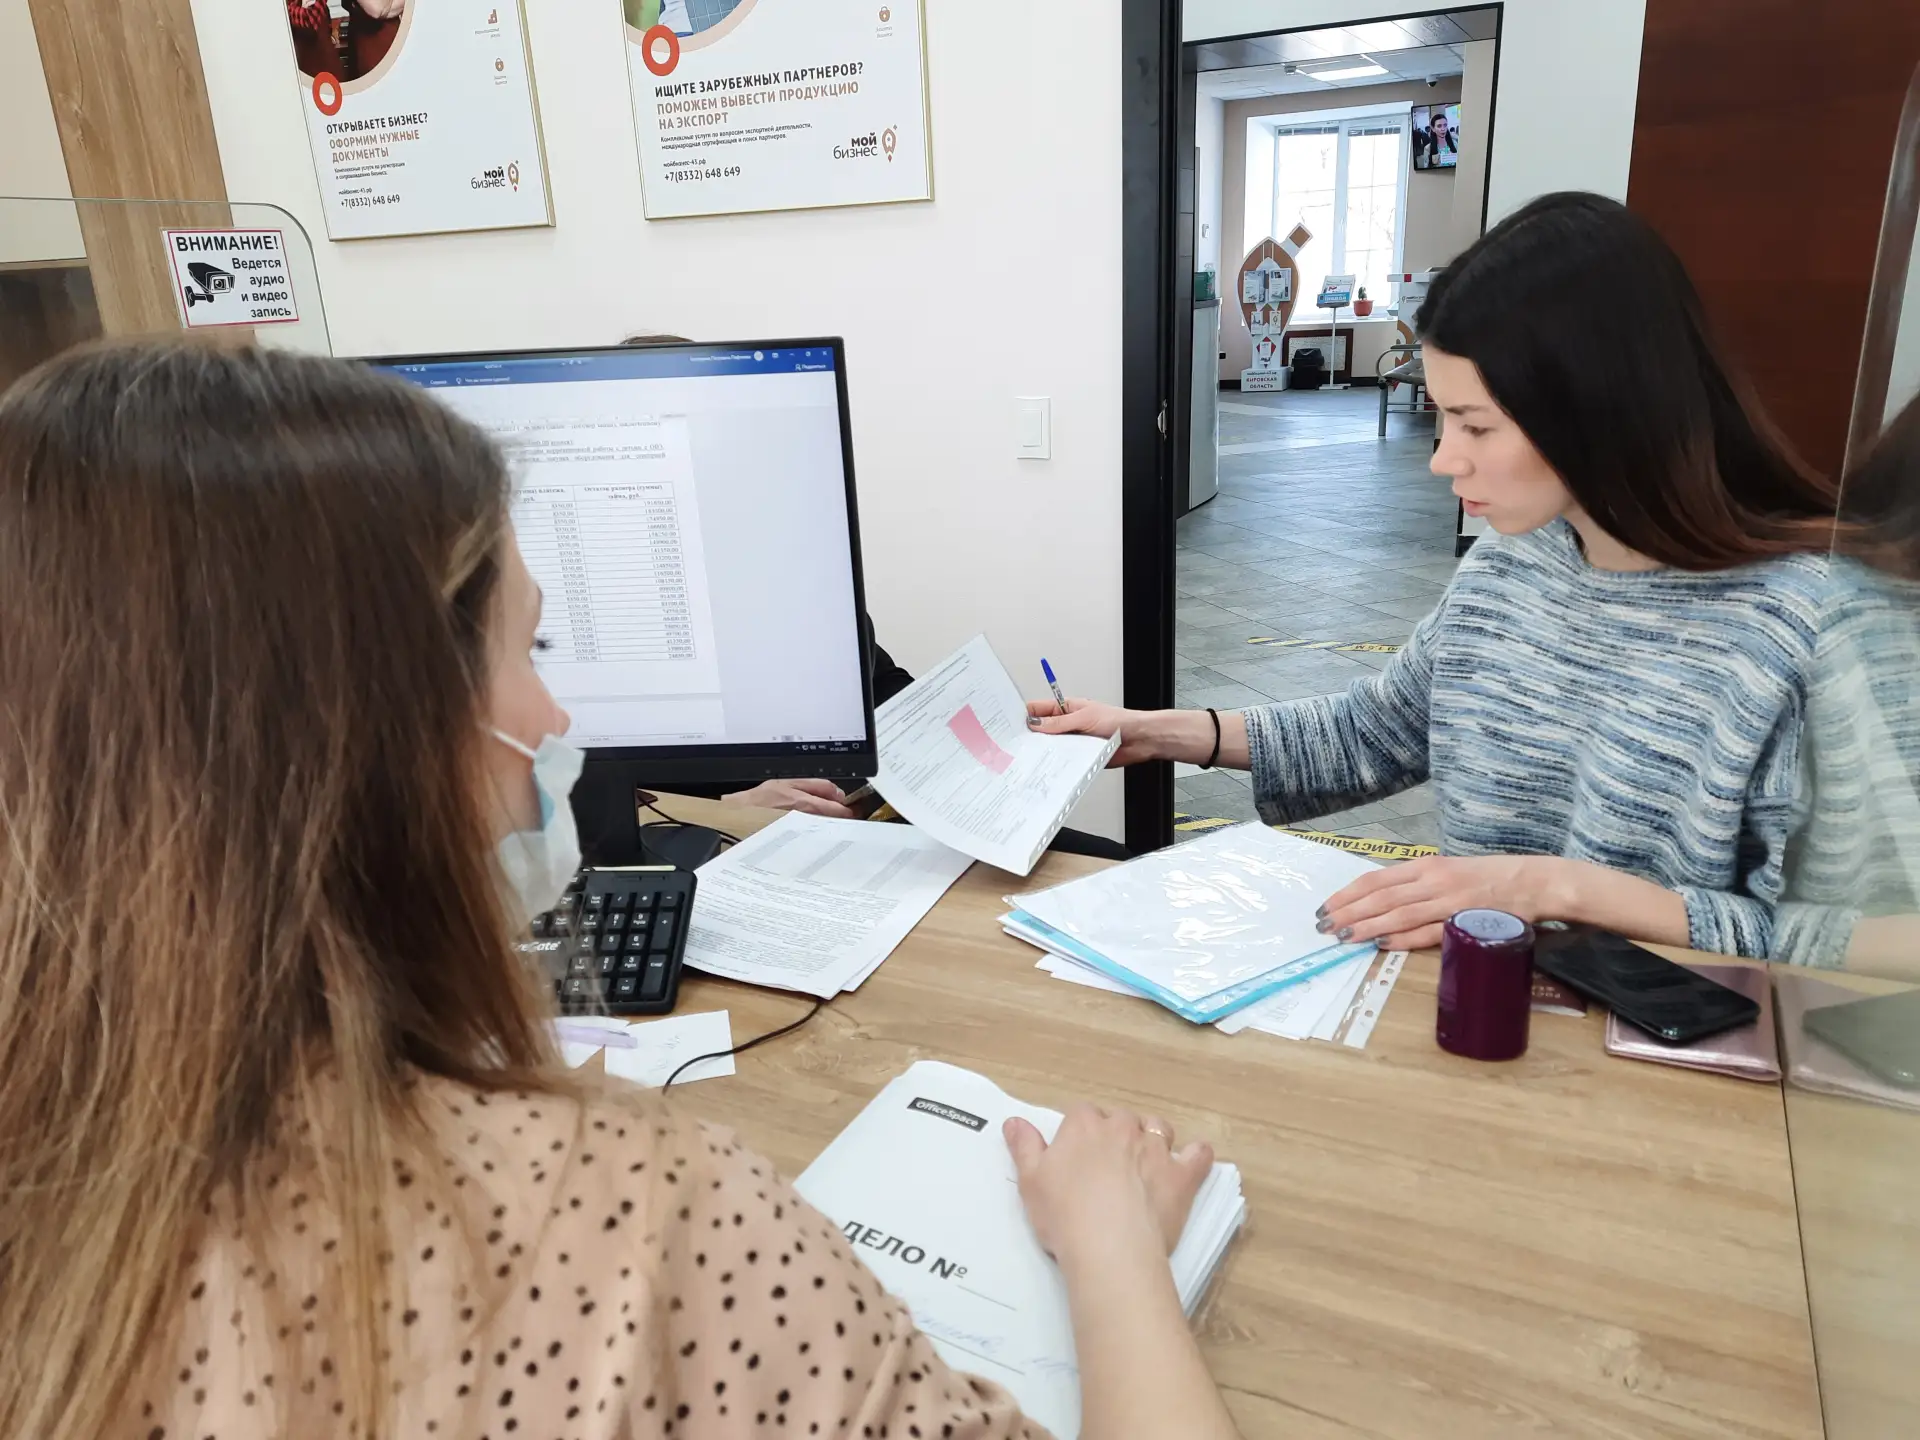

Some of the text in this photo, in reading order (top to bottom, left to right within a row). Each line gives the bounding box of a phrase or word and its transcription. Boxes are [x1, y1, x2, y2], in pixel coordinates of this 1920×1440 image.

[655, 62, 863, 98] ИЩИТЕ ЗАРУБЕЖНЫХ ПАРТНЕРОВ?
[657, 81, 859, 115] ПОМОЖЕМ ВЫВЕСТИ ПРОДУКЦИЮ
[326, 112, 428, 134] ОТКРЫВАЕТЕ БИЗНЕС?
[658, 112, 728, 130] НА ЭКСПОРТ
[329, 129, 420, 149] ОФОРМИМ НУЖНЫЕ
[851, 131, 877, 147] мой
[332, 147, 389, 164] ДОКУМЕНТЫ
[833, 145, 878, 160] бизнес
[484, 166, 505, 179] мой
[664, 166, 741, 184] +7(8332) 648 649
[471, 176, 506, 189] бизнес
[341, 194, 400, 209] +7(8332) 648 649
[175, 235, 279, 252] ВНИМАНИЕ!
[232, 257, 282, 270] Ведется
[249, 275, 285, 288] аудио
[241, 291, 288, 303] и видео
[251, 307, 292, 318] запись
[915, 1100, 979, 1127] OfficeSpace
[843, 1220, 926, 1265] ДЕЛО
